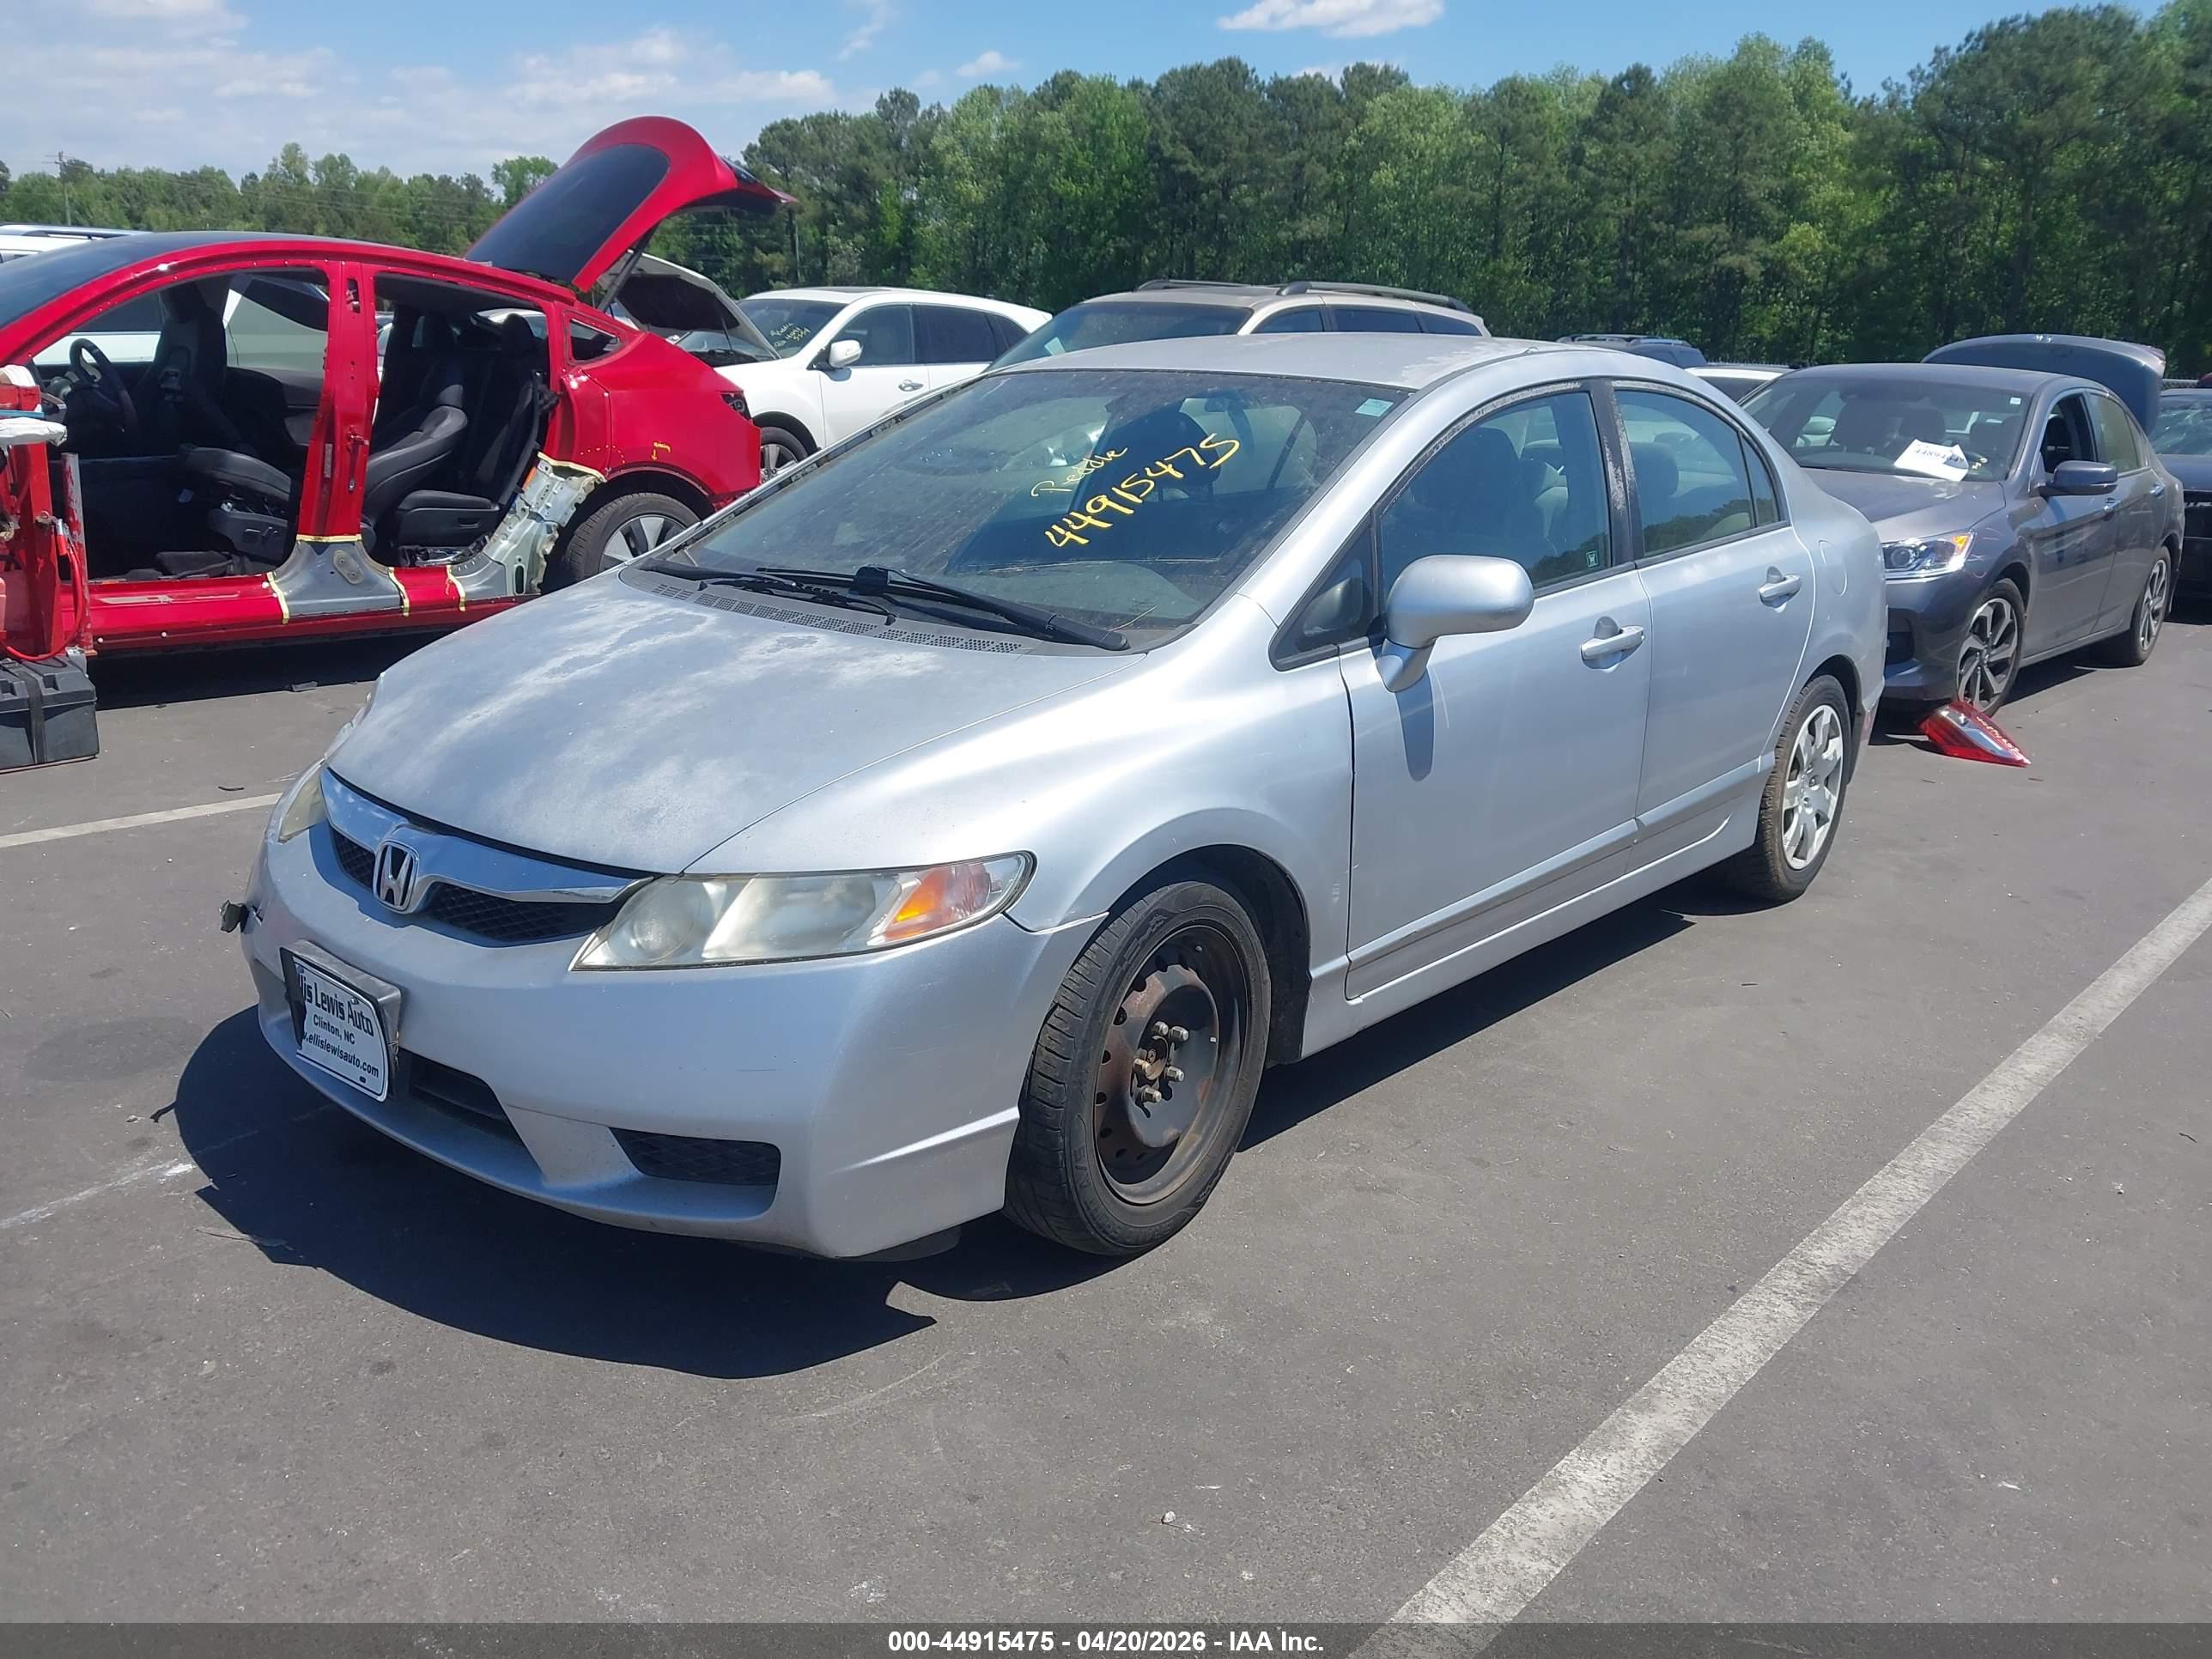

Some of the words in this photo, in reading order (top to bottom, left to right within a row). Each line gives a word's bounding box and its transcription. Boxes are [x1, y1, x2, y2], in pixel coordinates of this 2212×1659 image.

[1044, 433, 1241, 548] 44915475
[313, 1014, 342, 1040] Clinton,
[343, 1030, 356, 1045] NC
[314, 982, 344, 1020] Lewis
[348, 1000, 374, 1037] Auto
